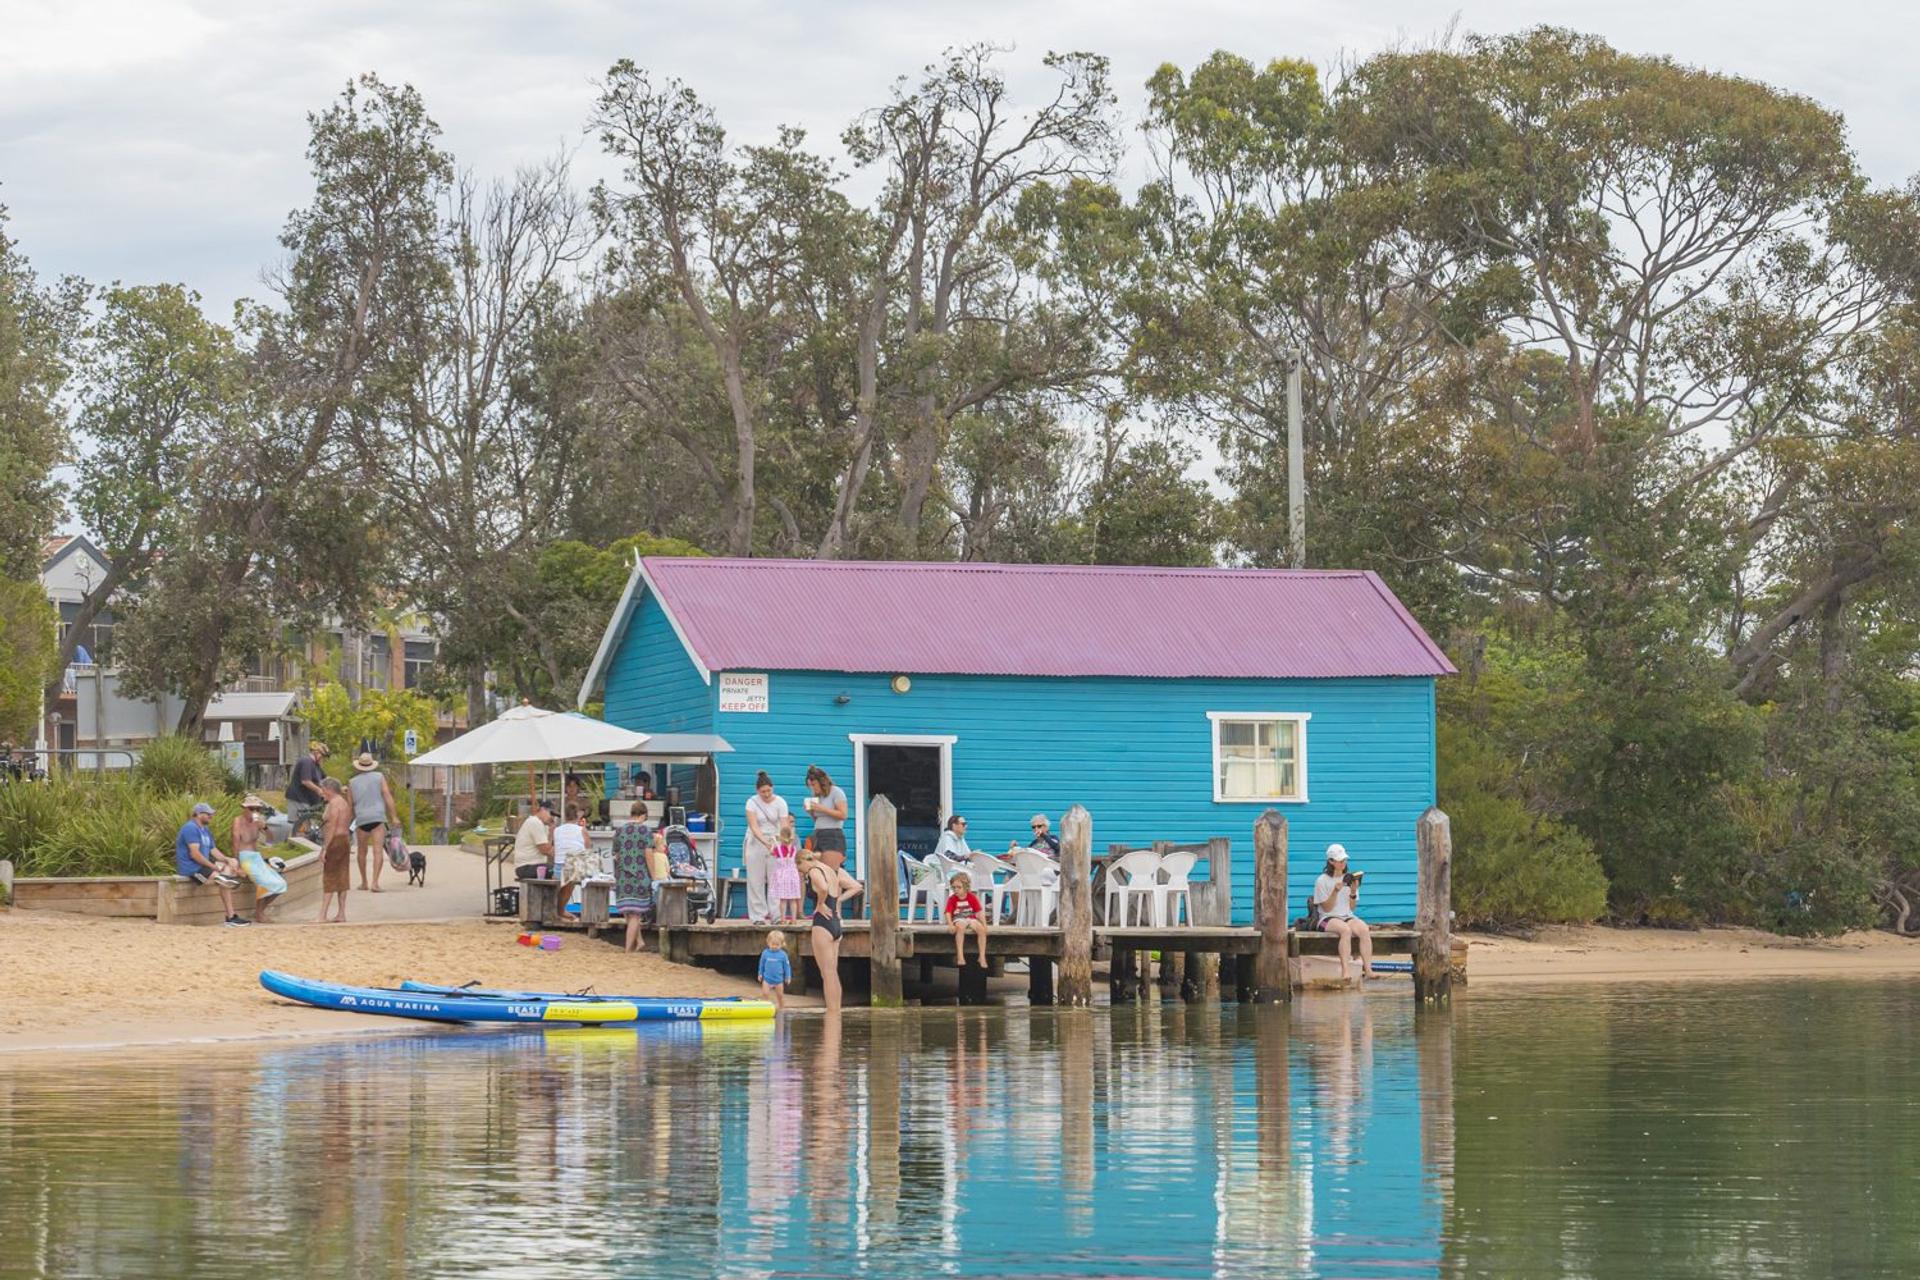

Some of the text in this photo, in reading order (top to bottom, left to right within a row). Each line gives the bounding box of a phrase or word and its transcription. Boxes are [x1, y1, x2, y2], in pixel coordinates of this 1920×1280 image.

[725, 678, 762, 686] DANGER
[721, 702, 766, 710] KEEP OFF
[360, 999, 440, 1012] AQUA MARINA
[507, 1006, 541, 1014] BEAST
[667, 1006, 698, 1014] BEAST
